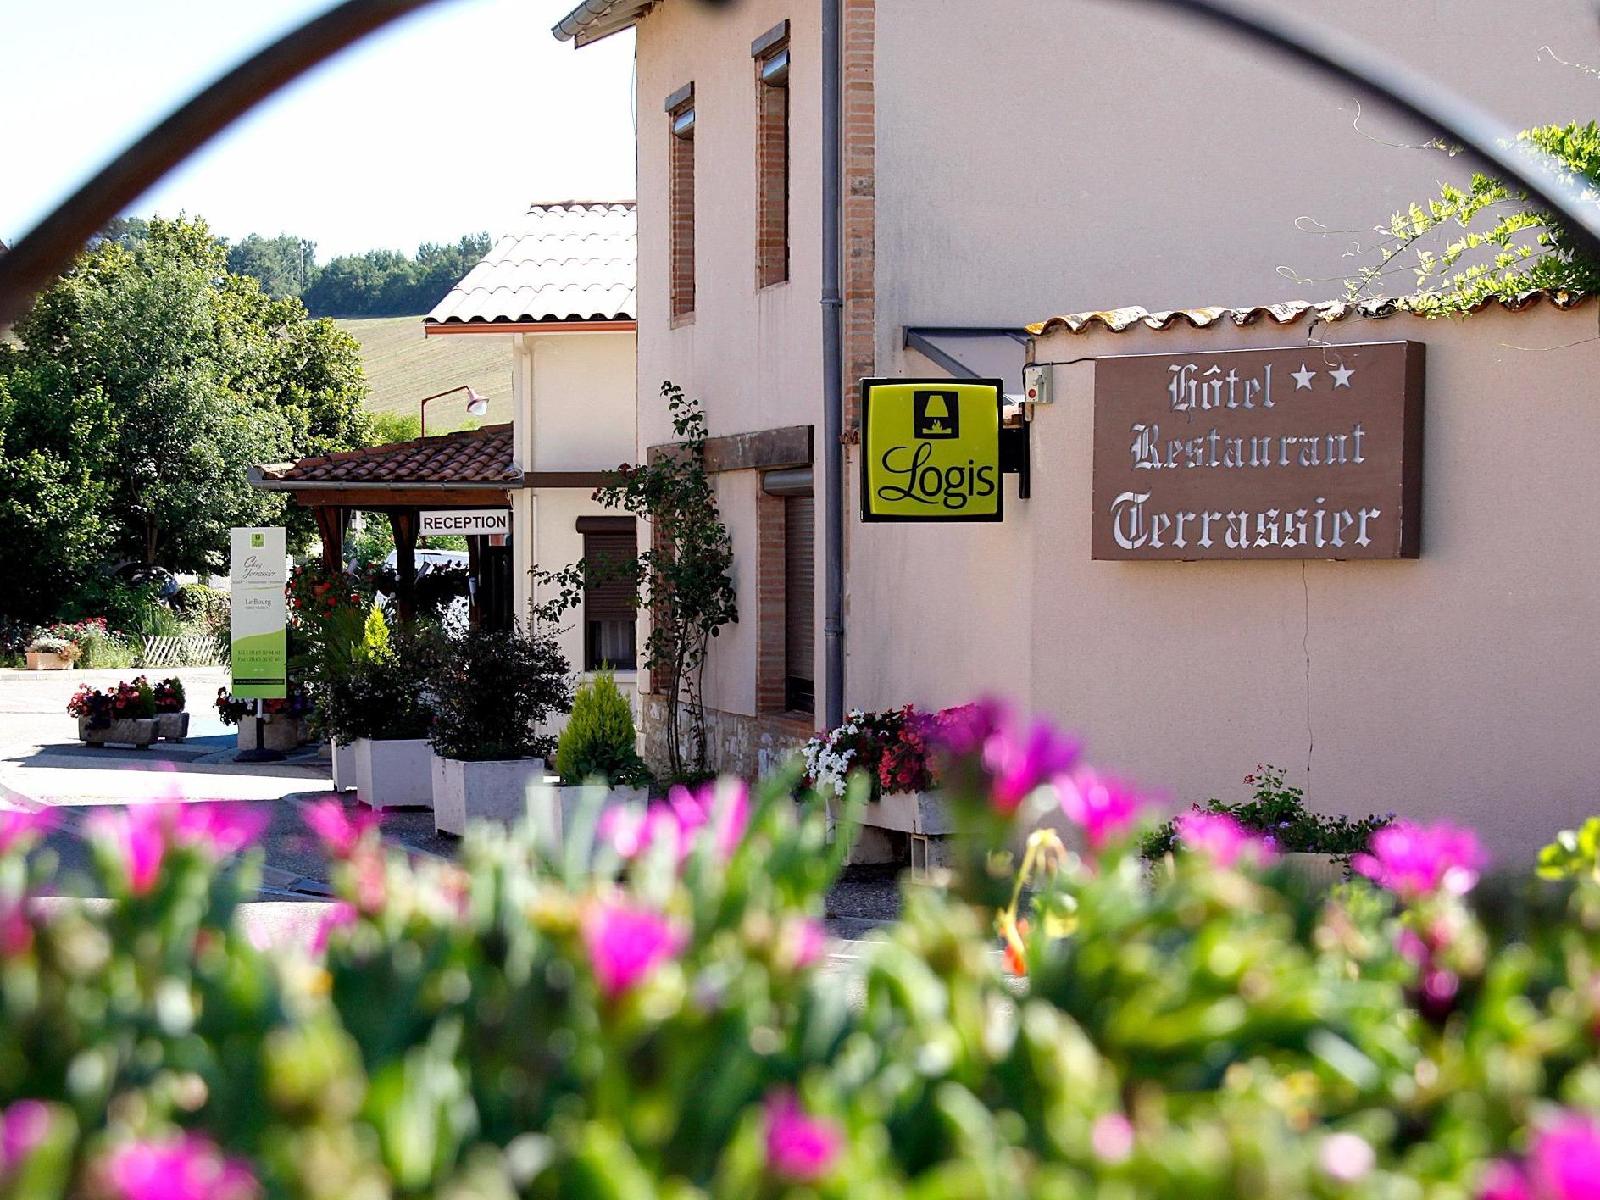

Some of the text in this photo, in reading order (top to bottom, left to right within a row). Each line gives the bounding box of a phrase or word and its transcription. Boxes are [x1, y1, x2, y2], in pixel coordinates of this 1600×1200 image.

[1167, 362, 1276, 413] Hôtel
[1130, 422, 1366, 470] Restaurant
[878, 442, 995, 509] Logis
[424, 516, 506, 529] RECEPTION
[1110, 489, 1382, 550] Terrassier
